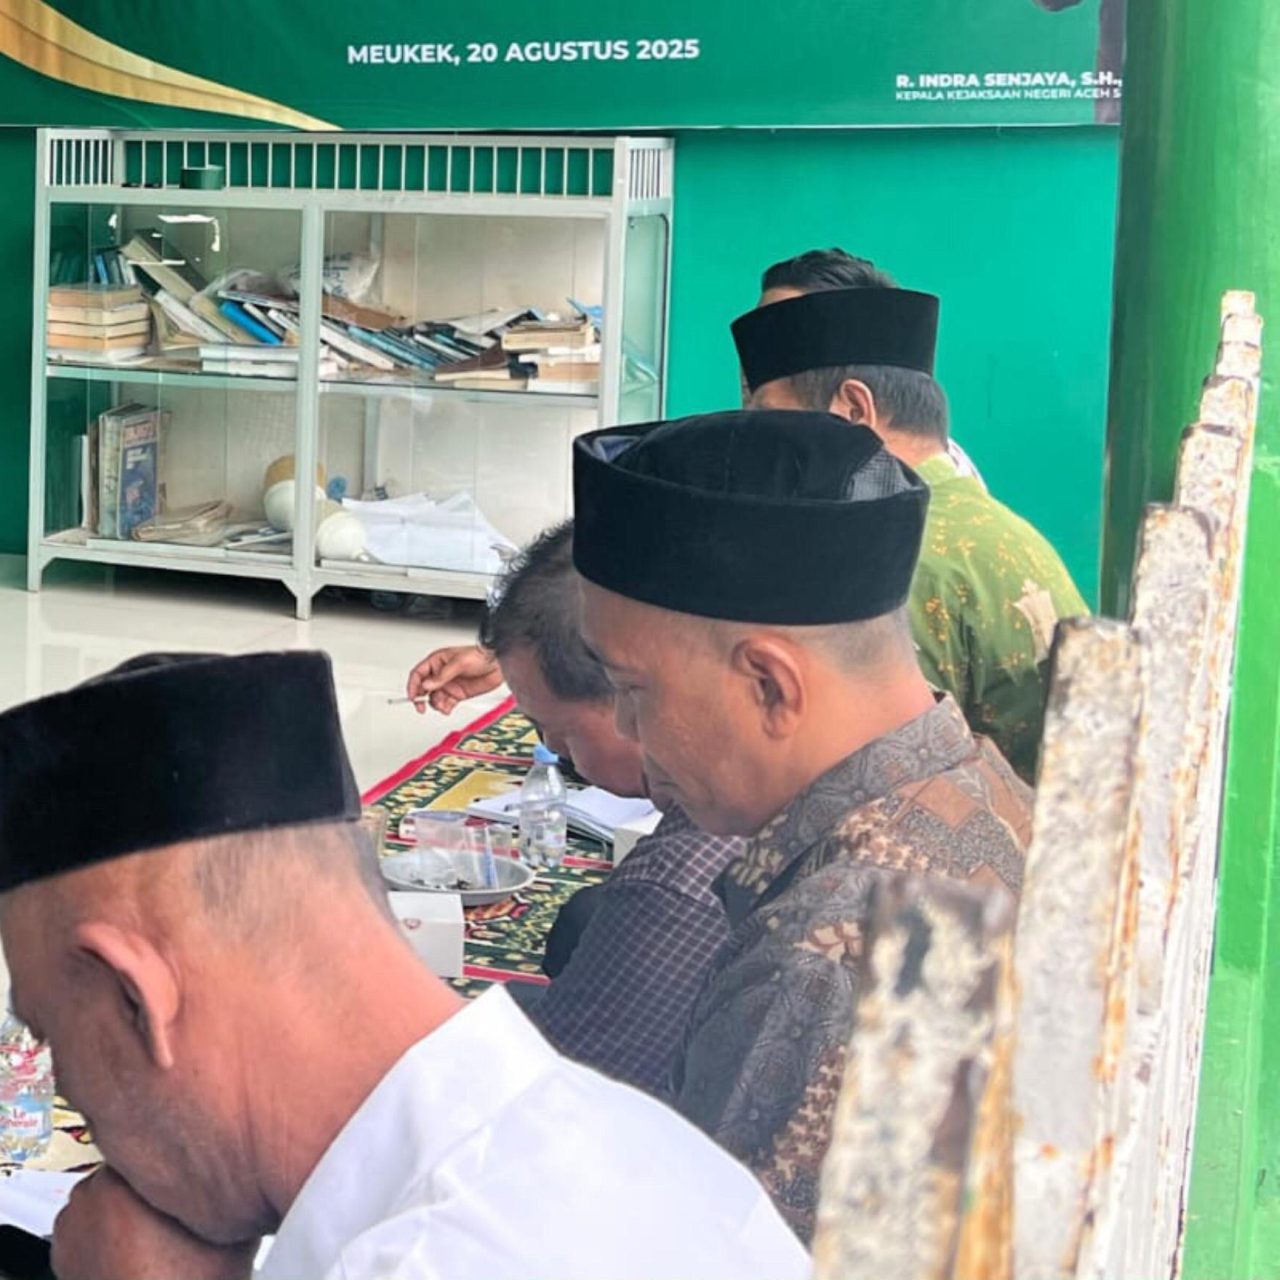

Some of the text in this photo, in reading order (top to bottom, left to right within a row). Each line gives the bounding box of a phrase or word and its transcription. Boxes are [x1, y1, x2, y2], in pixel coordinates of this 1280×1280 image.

[347, 38, 700, 66] MEUKEK, 20 AGUSTUS 2025
[896, 74, 915, 88] R.
[919, 73, 980, 88] INDRA
[984, 71, 1076, 89] SENJAYA,
[896, 89, 945, 101] KEPALA
[947, 89, 1021, 100] KEJAKSAAN
[1024, 88, 1071, 99] NEGERI
[1074, 88, 1111, 99] ACEH
